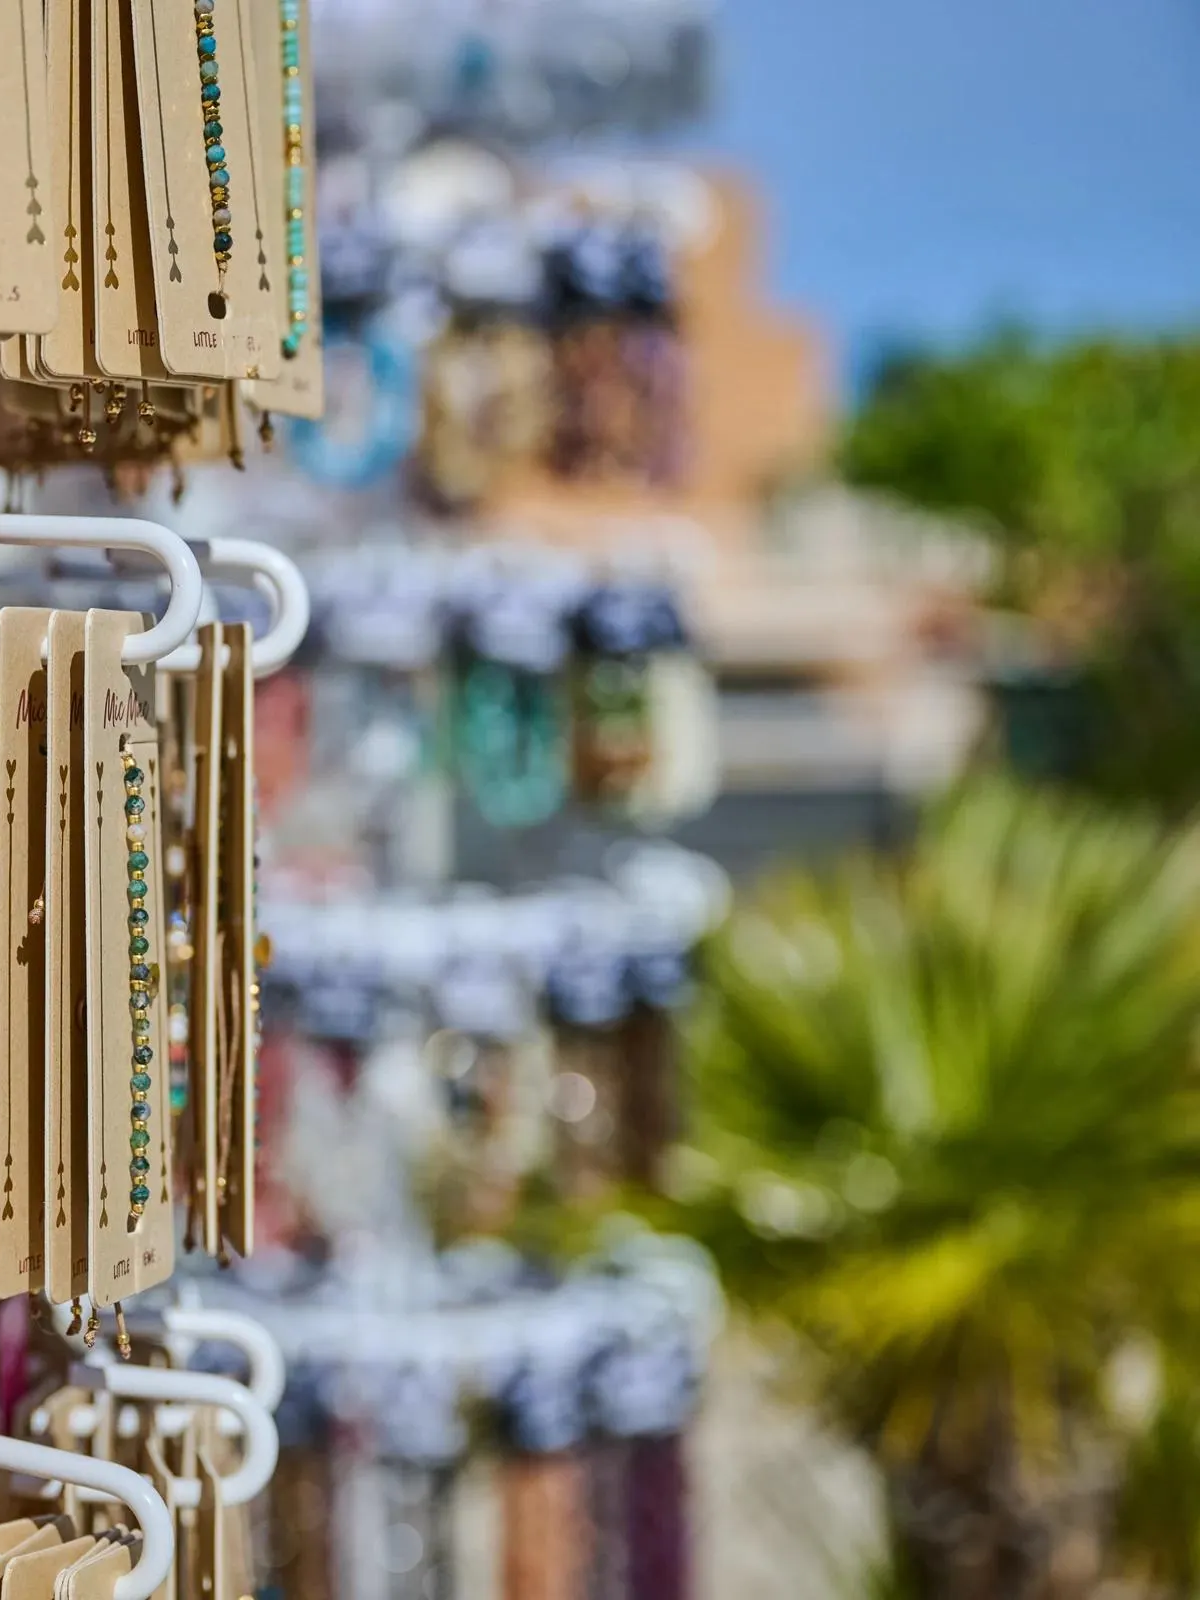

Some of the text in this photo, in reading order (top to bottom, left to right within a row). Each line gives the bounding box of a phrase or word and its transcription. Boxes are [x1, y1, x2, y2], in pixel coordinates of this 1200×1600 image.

[127, 329, 156, 347] LITTLE
[193, 330, 217, 348] LITTLE
[103, 688, 126, 729] Mic
[18, 1254, 43, 1275] LITTLE
[113, 1257, 130, 1280] LITTLE
